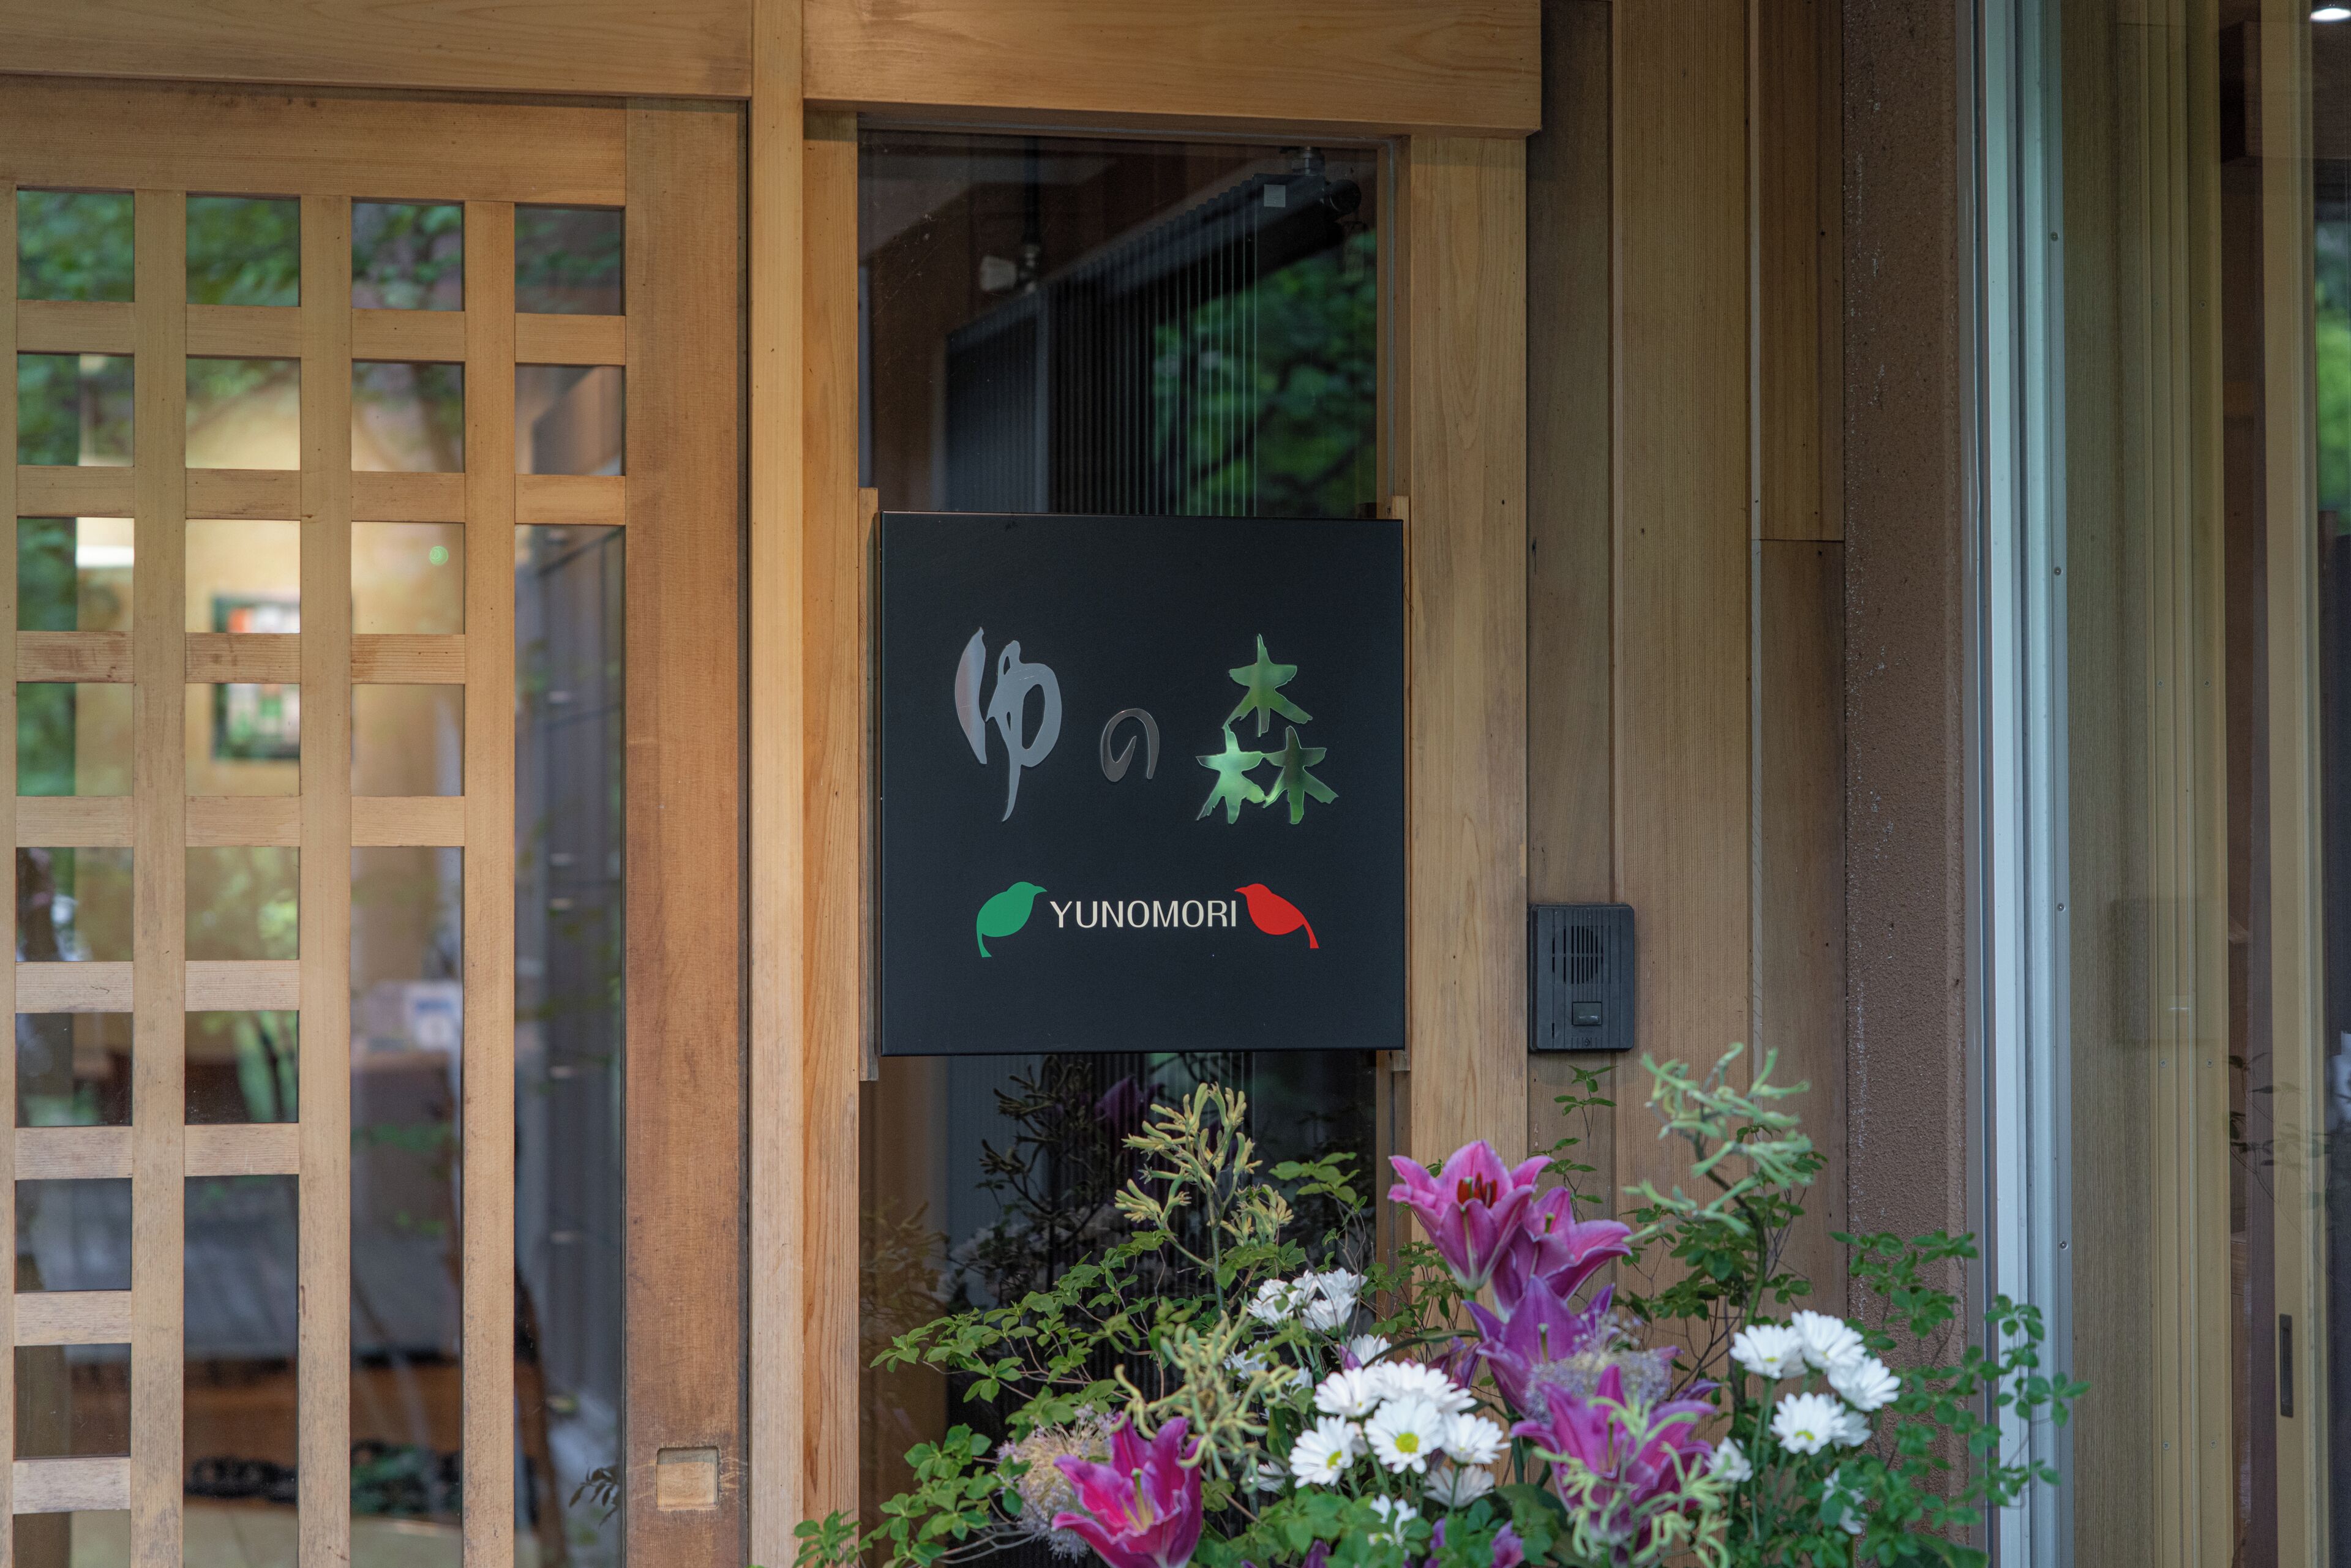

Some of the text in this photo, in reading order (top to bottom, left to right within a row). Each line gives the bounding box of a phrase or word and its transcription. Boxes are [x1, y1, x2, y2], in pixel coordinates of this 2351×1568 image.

[955, 627, 1339, 825] ゆの森
[1049, 900, 1237, 928] YUNOMORI
